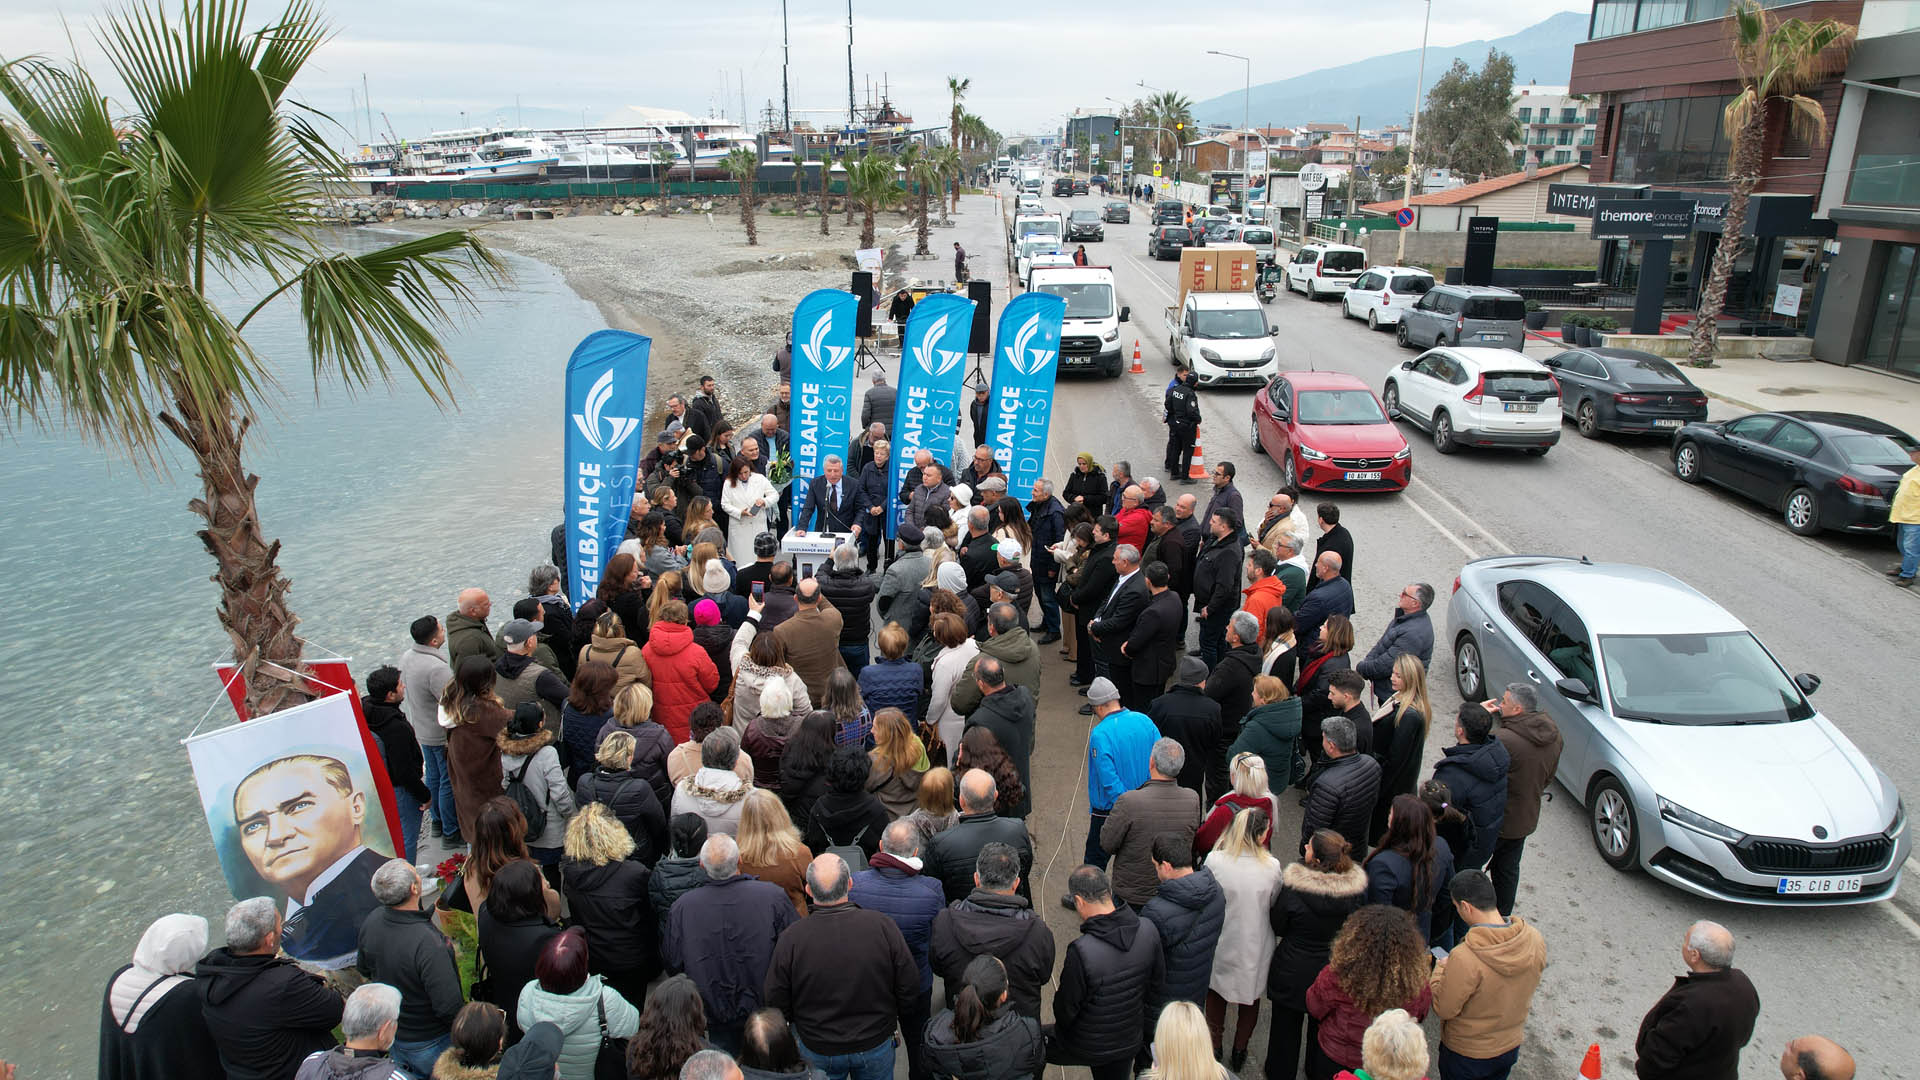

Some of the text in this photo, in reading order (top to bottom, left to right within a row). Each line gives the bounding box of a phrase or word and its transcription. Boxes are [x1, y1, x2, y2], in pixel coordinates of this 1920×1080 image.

[1787, 879, 1859, 891] 35 CIB 016
